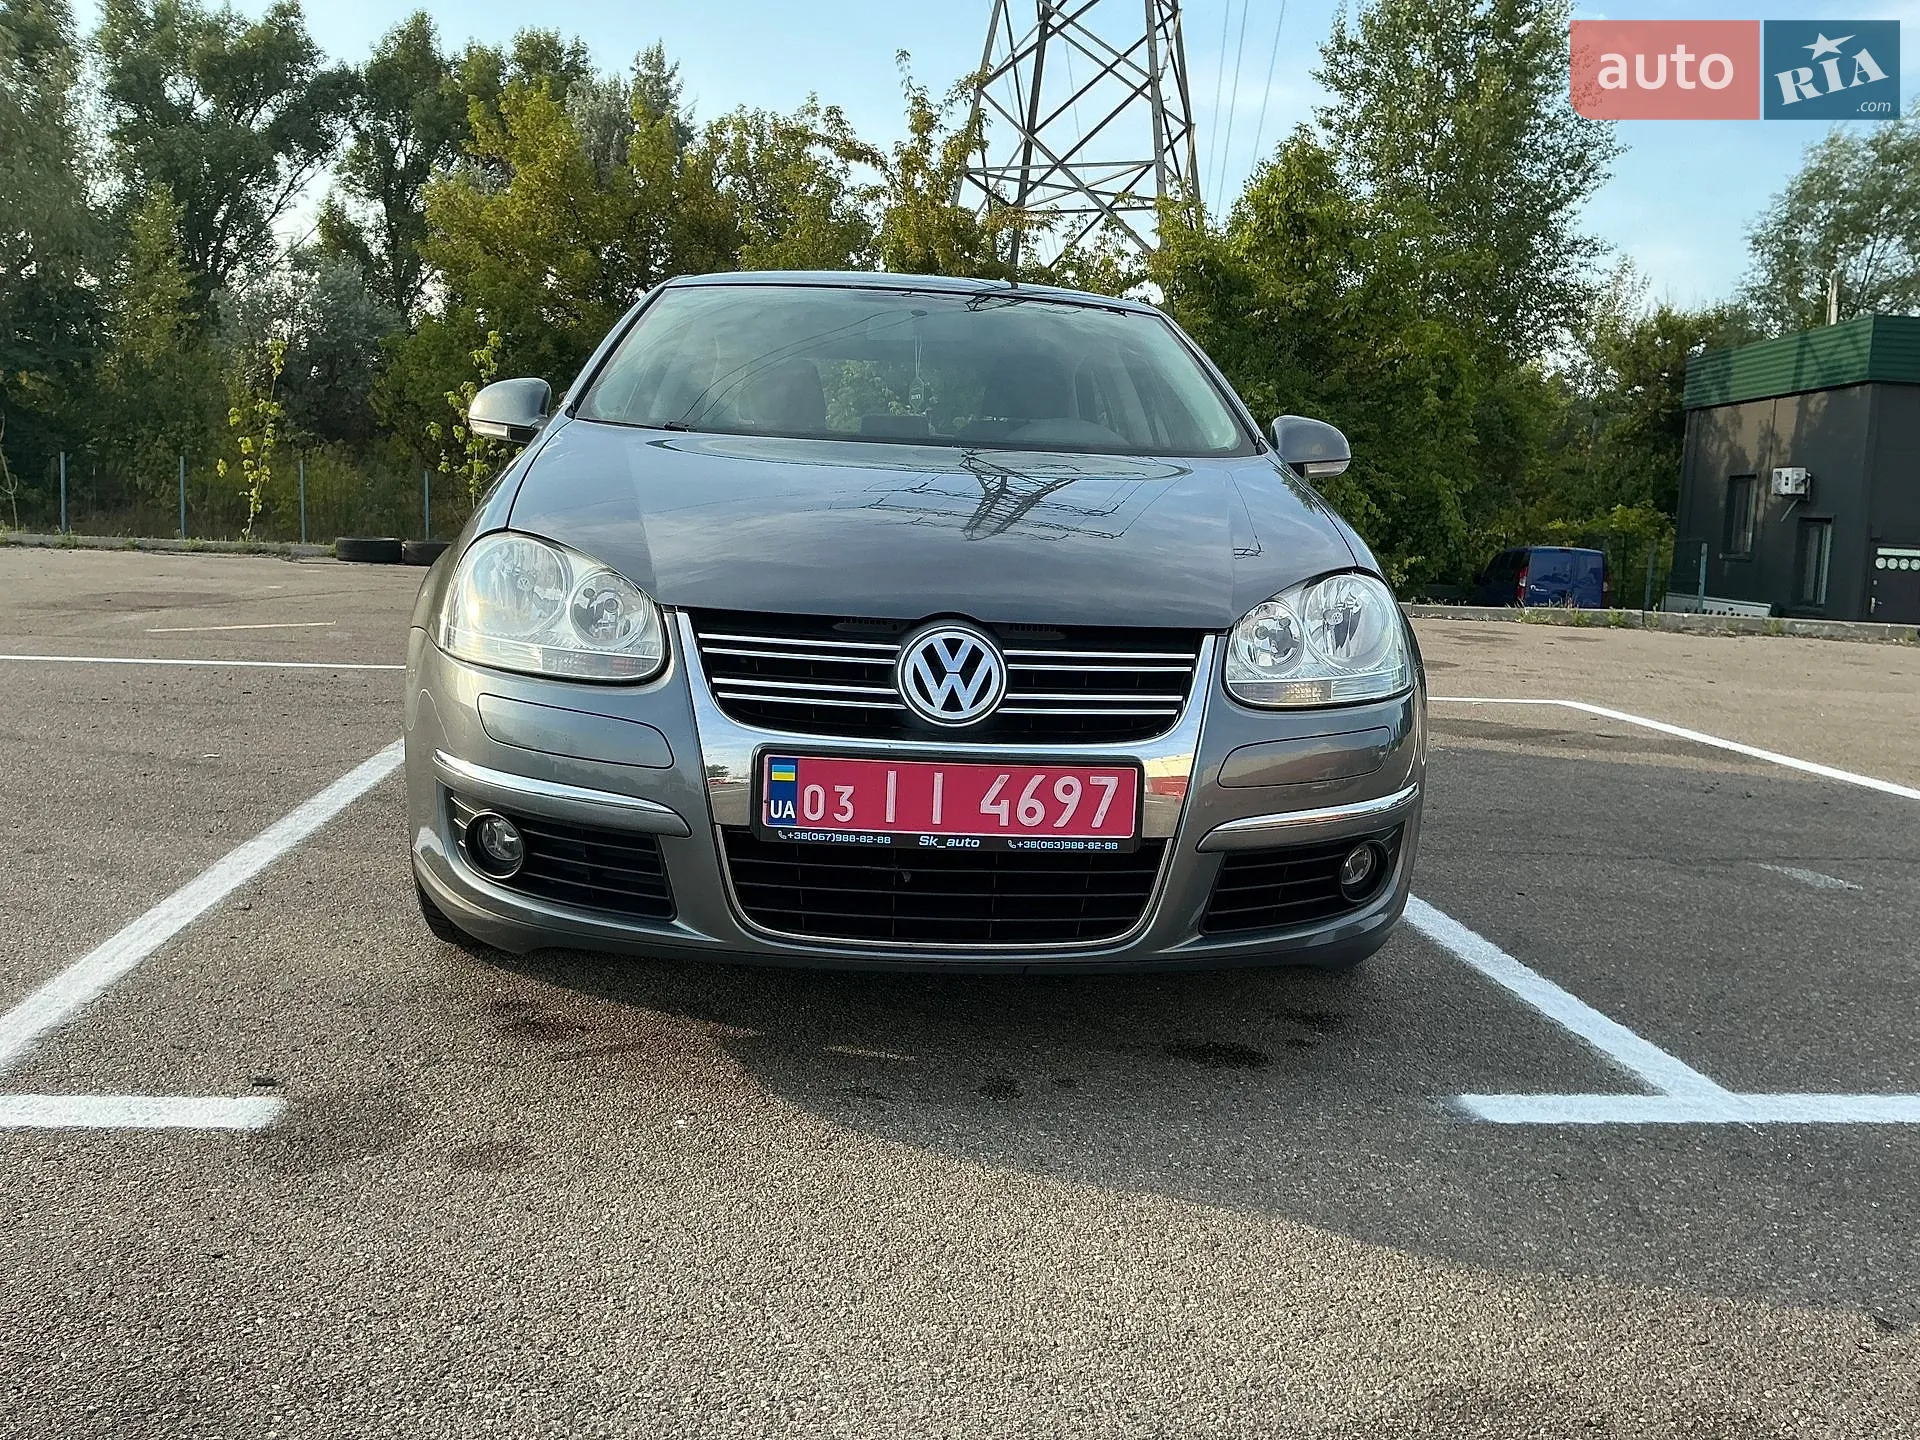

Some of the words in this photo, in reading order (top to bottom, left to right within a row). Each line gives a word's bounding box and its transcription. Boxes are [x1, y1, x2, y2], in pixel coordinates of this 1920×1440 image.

[904, 632, 1000, 720] VW
[770, 800, 795, 819] UA
[803, 784, 855, 823] 03
[979, 774, 1119, 829] 4697
[788, 831, 891, 844] +38(067)988-82-88
[919, 835, 980, 849] Sk_auto
[1017, 840, 1118, 851] +38(063)988-82-88
